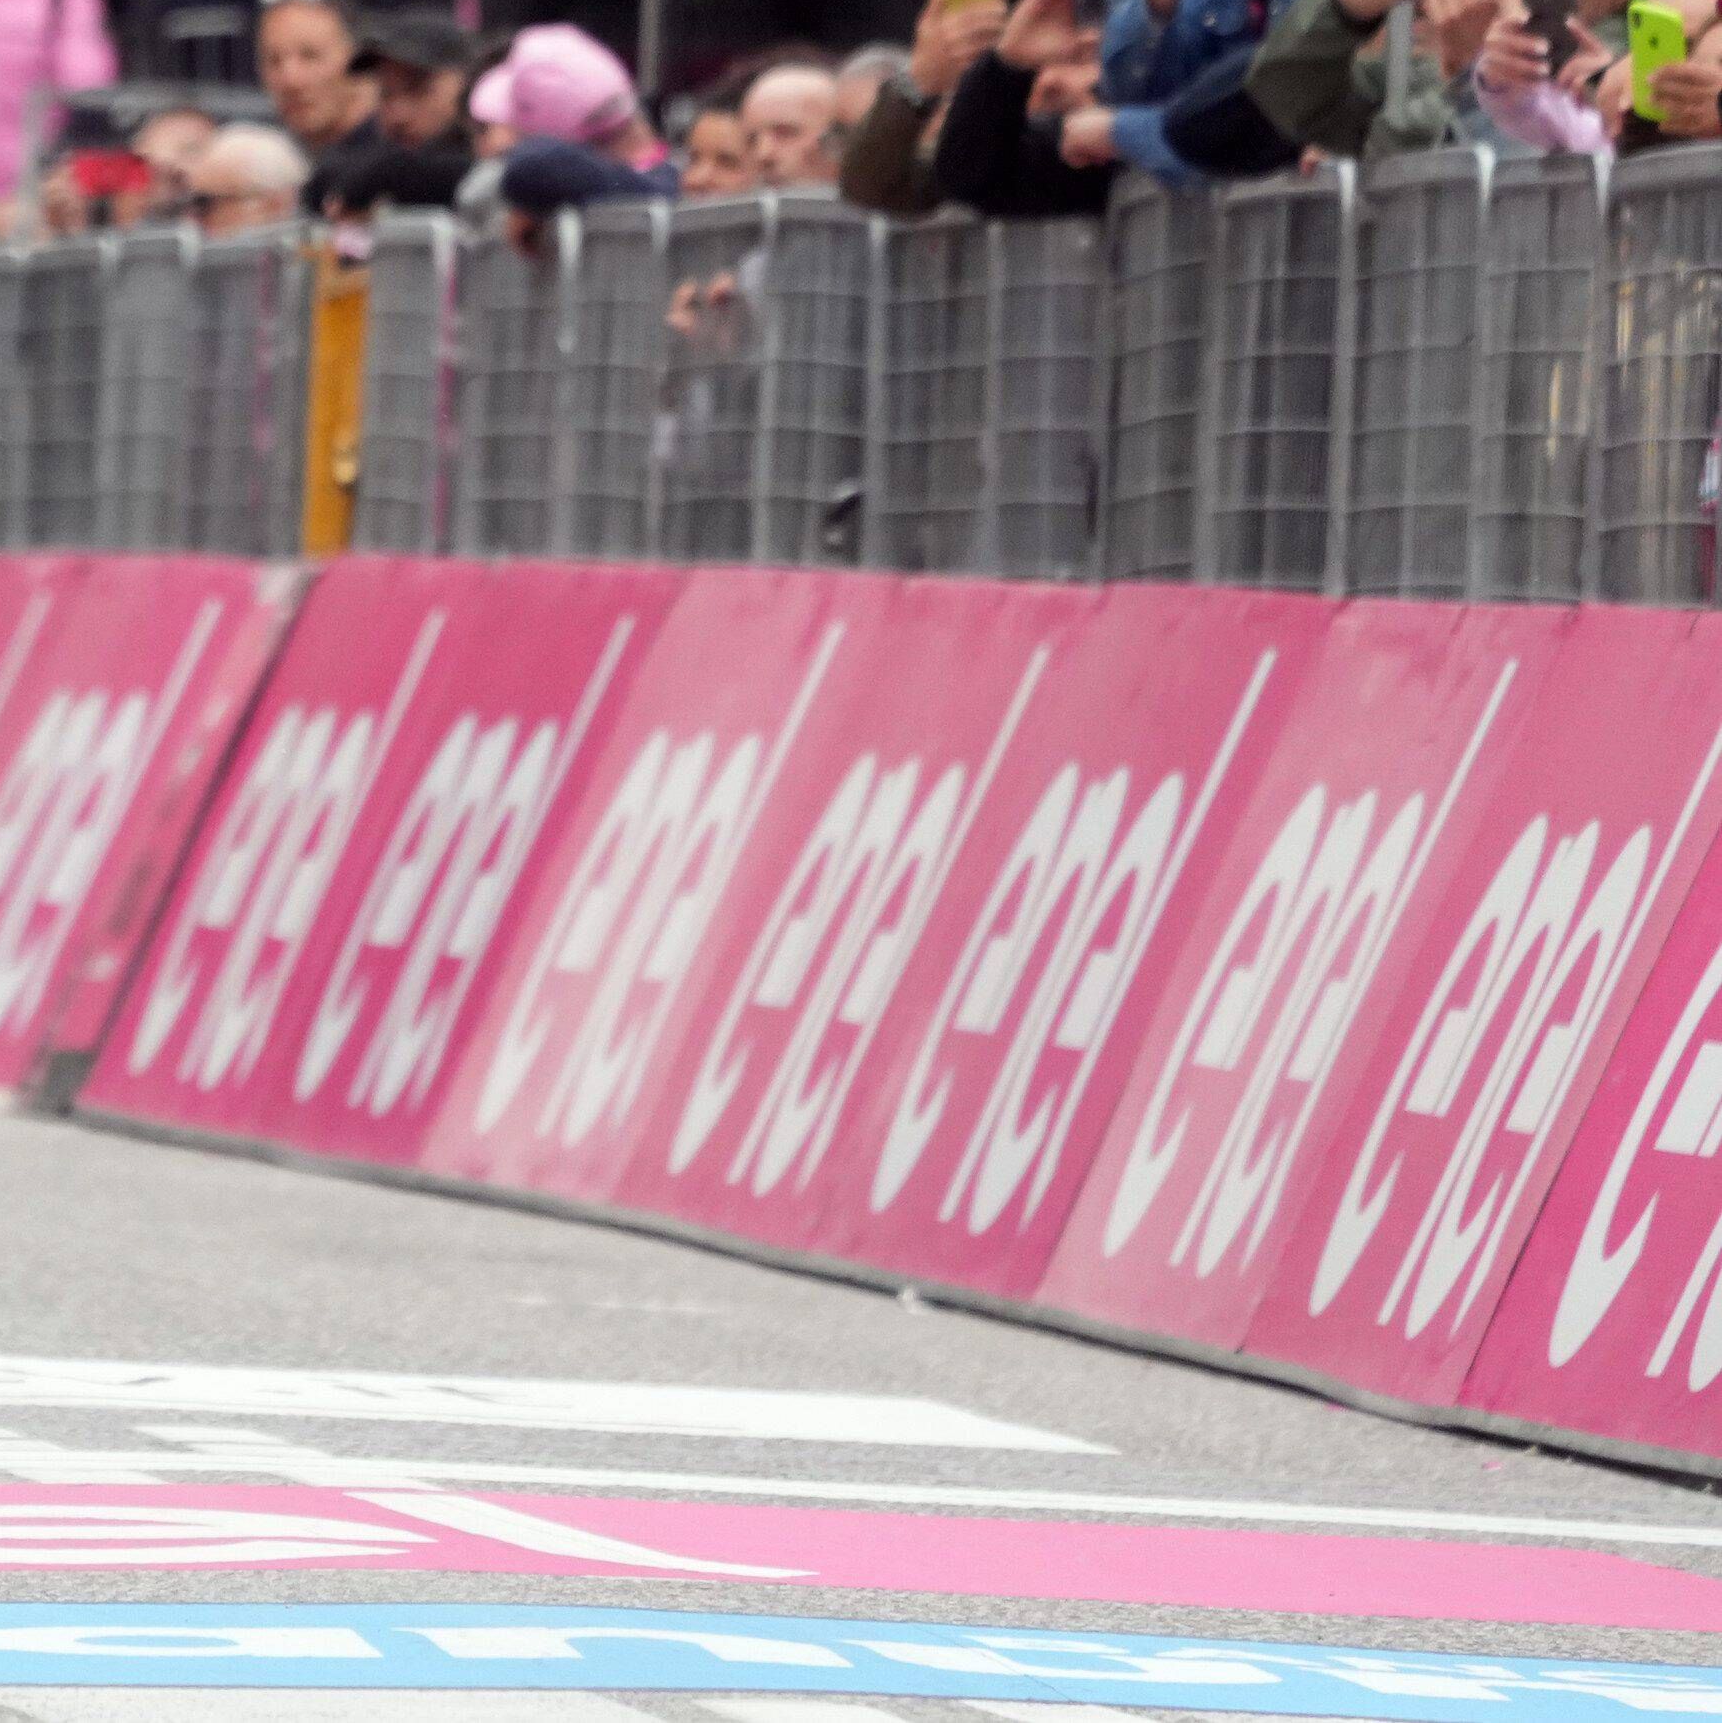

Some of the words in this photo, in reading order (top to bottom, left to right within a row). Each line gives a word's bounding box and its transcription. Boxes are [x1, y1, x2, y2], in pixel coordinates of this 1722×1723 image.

[473, 618, 847, 1152] enel
[667, 644, 1051, 1198] enel
[869, 646, 1278, 1236] enel
[1103, 656, 1519, 1280] enel
